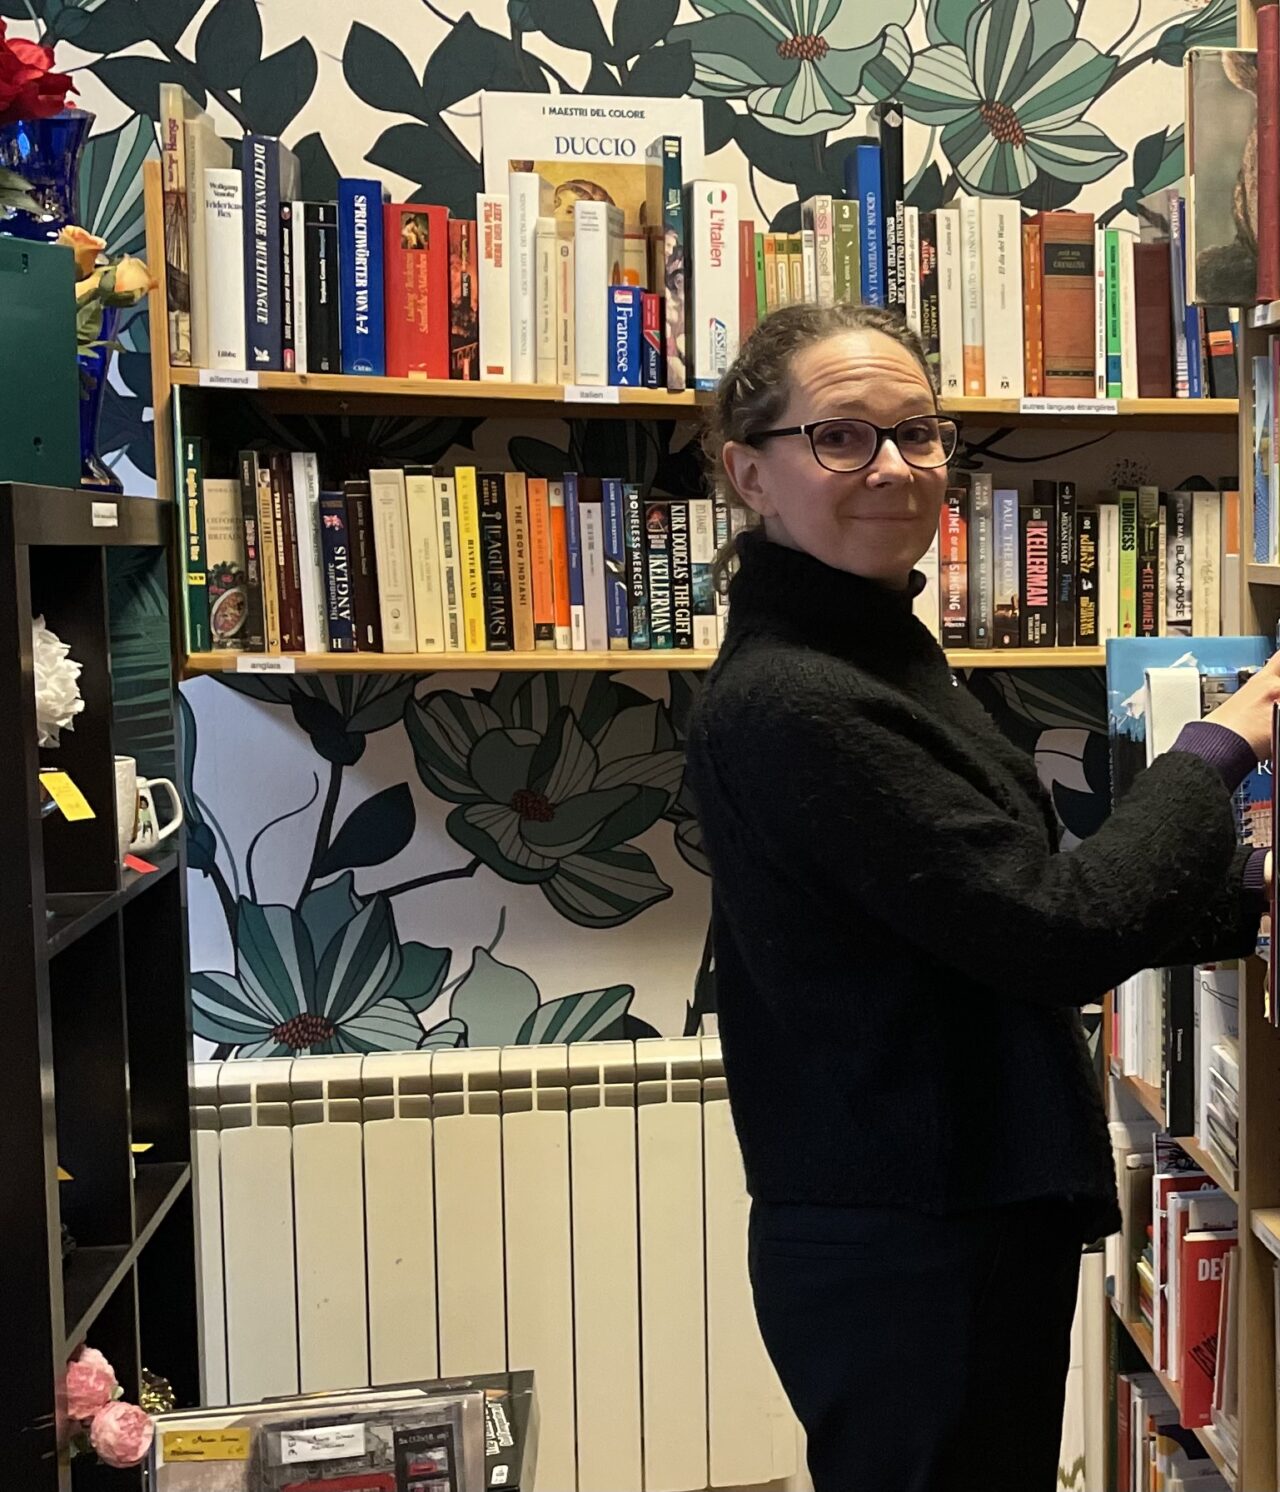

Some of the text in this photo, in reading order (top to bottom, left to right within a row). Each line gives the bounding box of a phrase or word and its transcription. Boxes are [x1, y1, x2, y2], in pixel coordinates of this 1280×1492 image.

[548, 107, 588, 119] MAESTRI
[589, 109, 608, 118] DEL
[608, 110, 647, 120] COLORE
[554, 135, 637, 158] DUCCIO
[254, 142, 269, 325] DICTIONNAIRE MULTILINGUE
[494, 203, 503, 222] ZEIT
[494, 224, 503, 241] DER
[841, 205, 850, 219] 3
[710, 209, 728, 268] L'Italien
[817, 234, 831, 276] Russell
[921, 240, 930, 275] ALLENDE
[354, 194, 370, 335] SPRICHWÖRTER VON A-Z
[616, 306, 633, 373] Francese
[208, 374, 250, 385] allemand
[1022, 402, 1117, 413] autres langues étrangères
[273, 492, 282, 518] TRAIN
[514, 505, 524, 525] THE
[629, 494, 640, 549] BONELESS
[948, 506, 960, 534] TIME
[1061, 511, 1069, 542] MEGAN
[1122, 502, 1135, 552] BURGESS
[515, 528, 525, 559] CROW
[979, 536, 987, 560] BOOK
[1003, 499, 1015, 597] PAUL THEROUX
[1061, 542, 1069, 565] HART
[1175, 524, 1184, 542] MAY
[333, 545, 351, 622] ANGLAIS
[467, 539, 477, 599] HINTERLAND
[484, 524, 507, 635] LEAGUE LIARS
[633, 551, 643, 597] MERCIES
[670, 504, 691, 635] KIRK DOUGLAS THE GIFT
[948, 564, 961, 611] SINGING
[1026, 527, 1048, 606] KELLERMAN
[1175, 545, 1185, 617] BLACKHOUSE
[328, 562, 338, 621] Dictionnaire
[649, 557, 671, 634] KELLERMAN
[1142, 568, 1154, 630] KITE RUNNER
